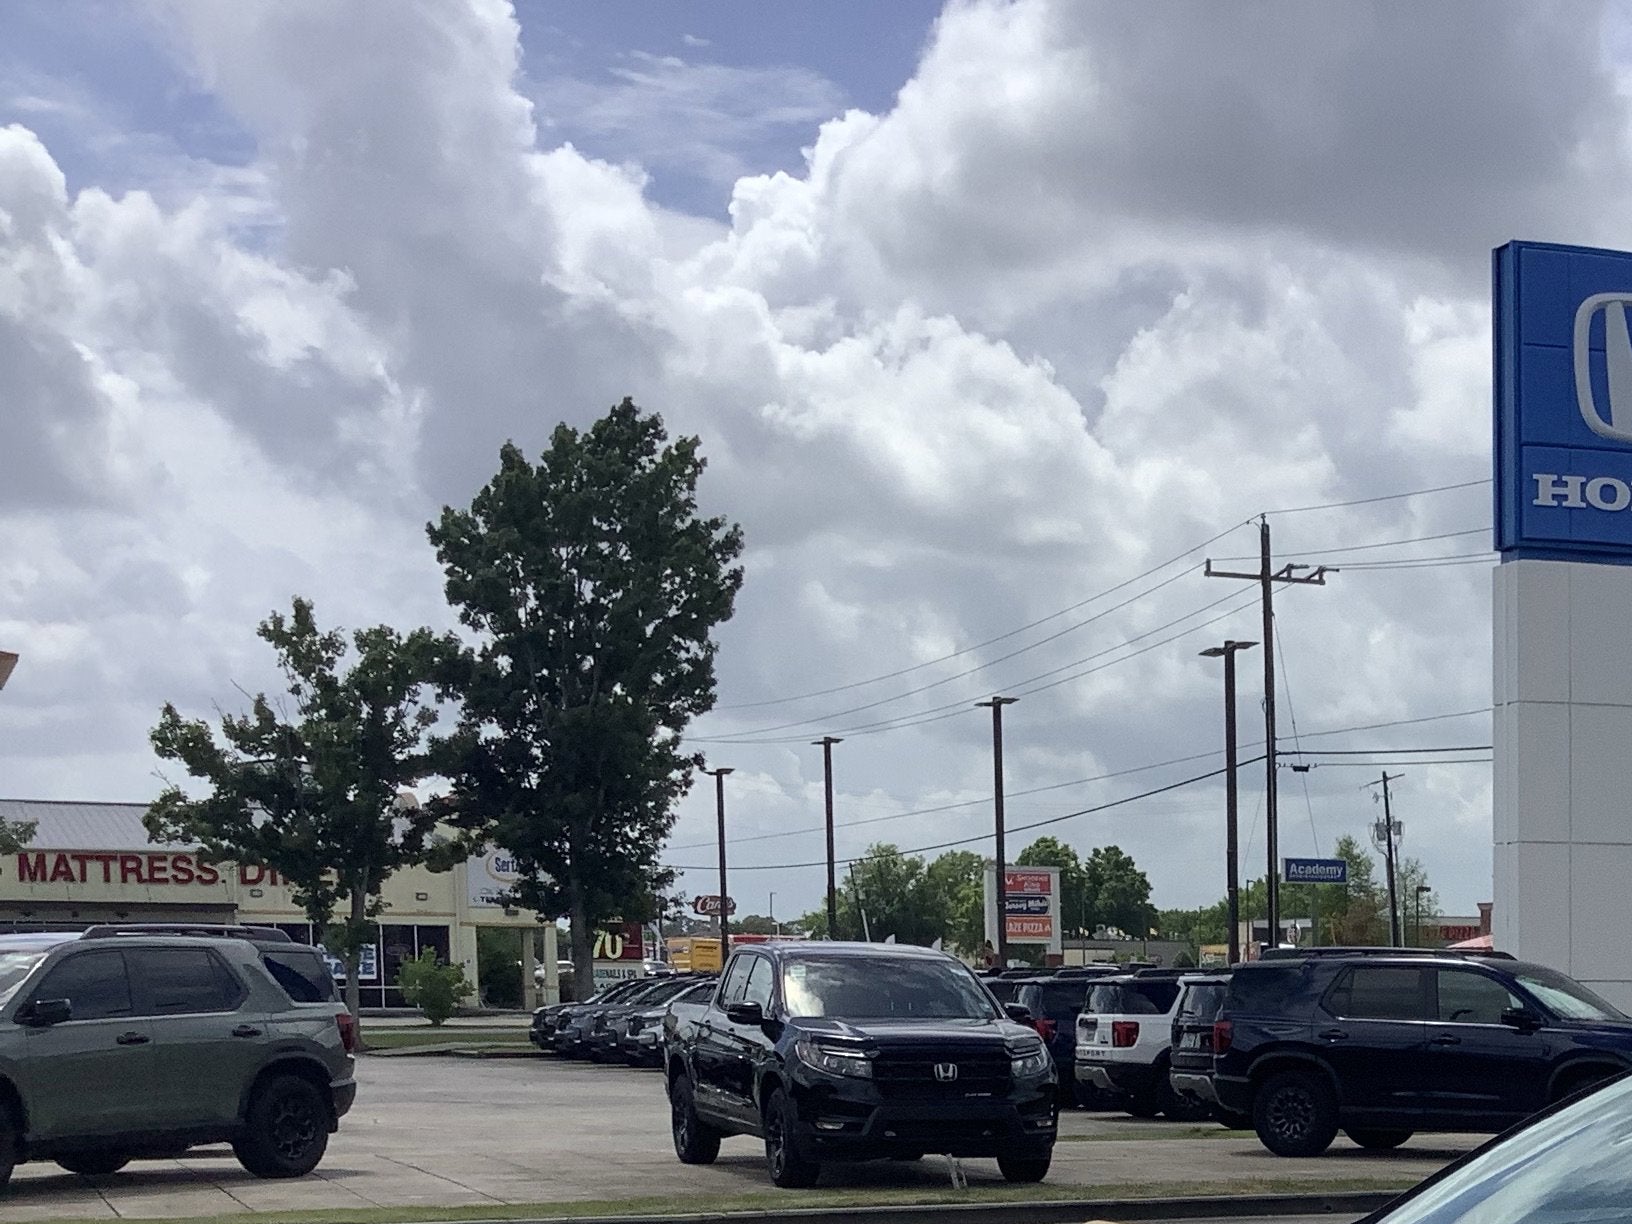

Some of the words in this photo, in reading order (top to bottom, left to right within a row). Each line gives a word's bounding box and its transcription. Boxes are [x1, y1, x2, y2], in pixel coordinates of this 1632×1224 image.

[17, 853, 219, 885] MATTRESS
[495, 857, 521, 873] Sert
[1290, 863, 1344, 878] Academy
